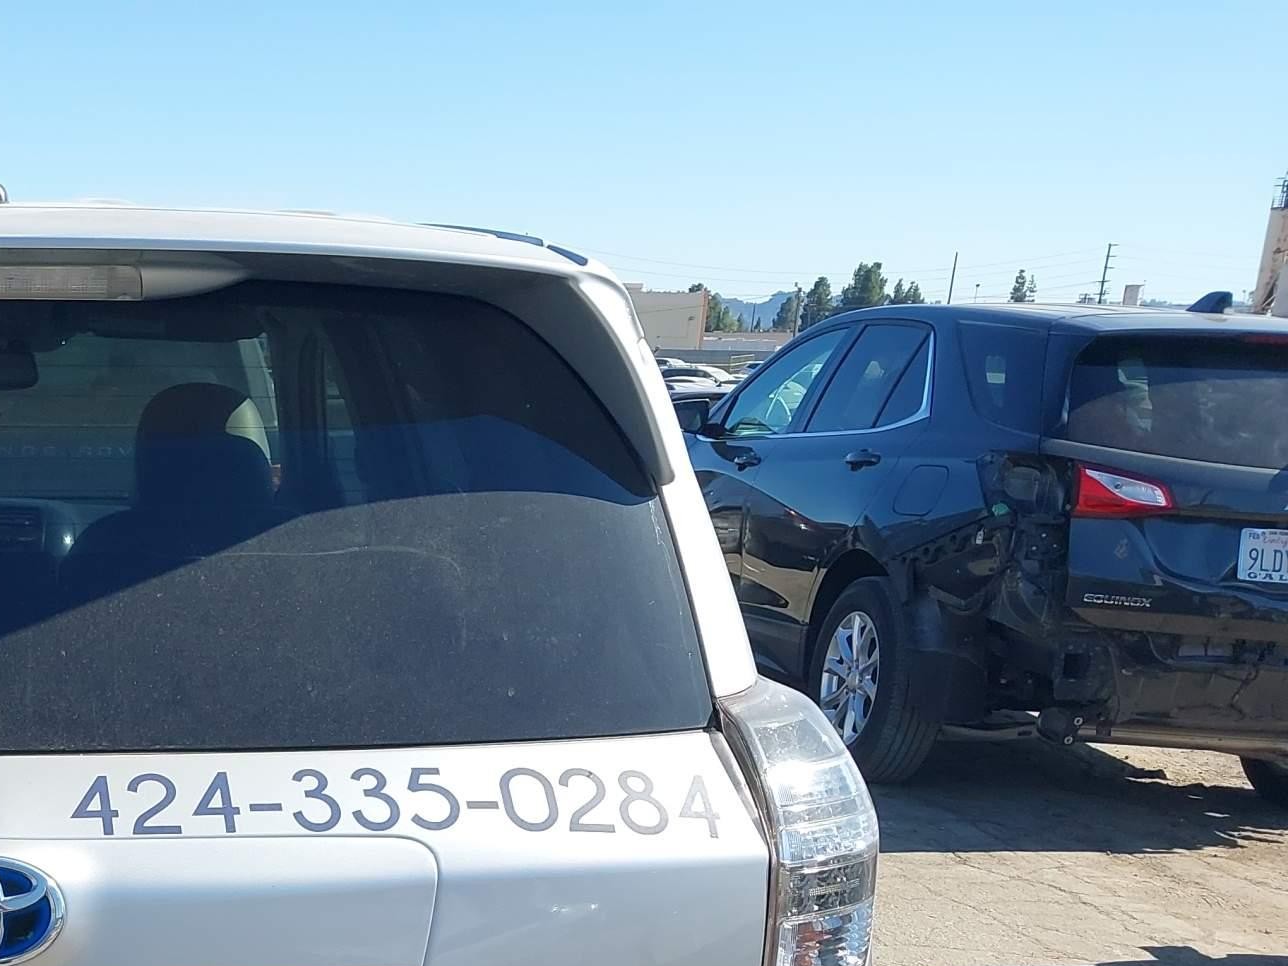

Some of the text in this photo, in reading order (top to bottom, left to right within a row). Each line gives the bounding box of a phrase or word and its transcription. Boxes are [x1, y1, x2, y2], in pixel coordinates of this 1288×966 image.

[1247, 547, 1288, 573] 9LD
[1083, 593, 1152, 608] EQUINOX
[70, 765, 720, 840] 424-335-0284
